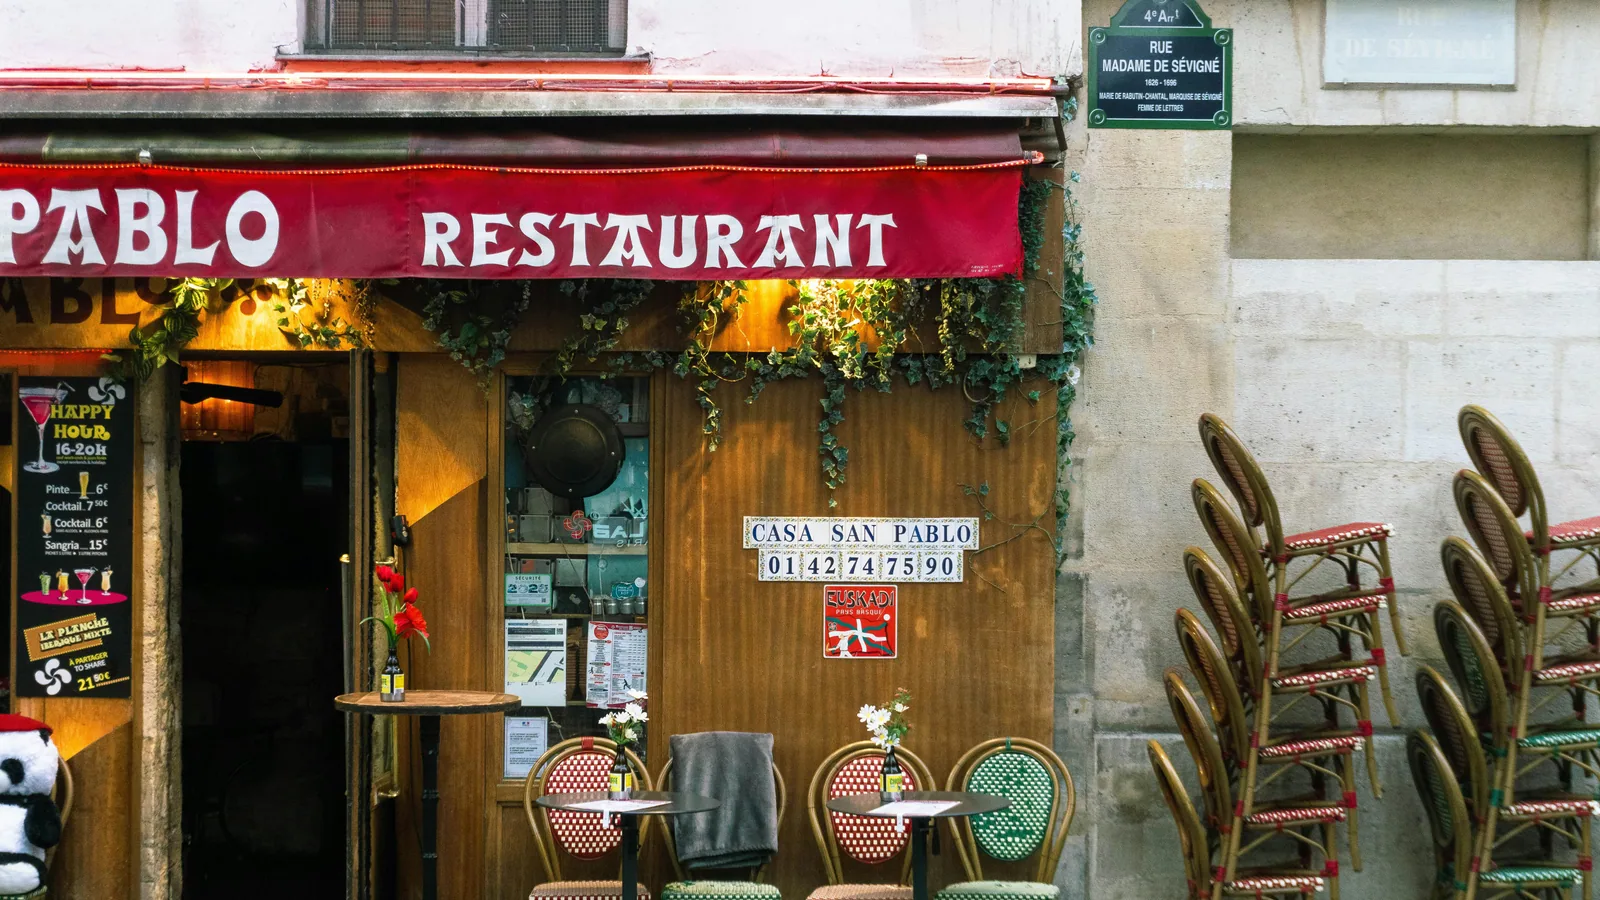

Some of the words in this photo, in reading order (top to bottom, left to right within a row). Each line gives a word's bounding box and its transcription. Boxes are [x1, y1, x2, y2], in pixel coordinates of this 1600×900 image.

[1149, 41, 1173, 54] RUE
[1345, 38, 1378, 57] DE
[1386, 32, 1495, 59] SÉVIGNÉ
[1102, 59, 1151, 72] MADAME
[1153, 59, 1169, 72] DE
[1171, 56, 1220, 73] SÉVIGNÉ
[1099, 92, 1114, 100] MARIE
[1115, 92, 1122, 100] DE
[1122, 92, 1168, 101] RABUTIN-CHANTAL,
[1169, 93, 1194, 101] MARQUISE
[1194, 93, 1201, 101] DE
[1201, 91, 1223, 101] SÉVIGNÉ
[1137, 104, 1154, 112] FEMME
[1155, 104, 1162, 112] DE
[1162, 104, 1184, 112] LETTRES
[0, 187, 280, 268] PABLO
[421, 211, 897, 270] RESTAURANT
[51, 404, 115, 420] HAPPY
[54, 424, 111, 441] HOUR
[46, 484, 70, 494] Pinte
[96, 483, 108, 494] 6€
[46, 501, 82, 511] Cocktail
[54, 518, 91, 528] Cocktail
[95, 517, 108, 528] 6€
[752, 523, 814, 542] CASA
[831, 523, 877, 542] SAN
[894, 523, 971, 543] PABLO
[45, 540, 79, 552] Sangria
[89, 539, 108, 550] 15€
[768, 556, 794, 575] 01
[808, 556, 836, 575] 42
[848, 556, 874, 575] 74
[886, 556, 914, 576] 75
[925, 556, 953, 576] 90
[826, 590, 894, 608] EUSKADI
[40, 630, 55, 641] LA
[57, 617, 109, 637] PLANCHE
[83, 627, 112, 641] MIXTE
[69, 658, 75, 666] À
[75, 651, 109, 665] PARTAGER
[74, 664, 84, 672] TO
[84, 659, 106, 670] SHARE
